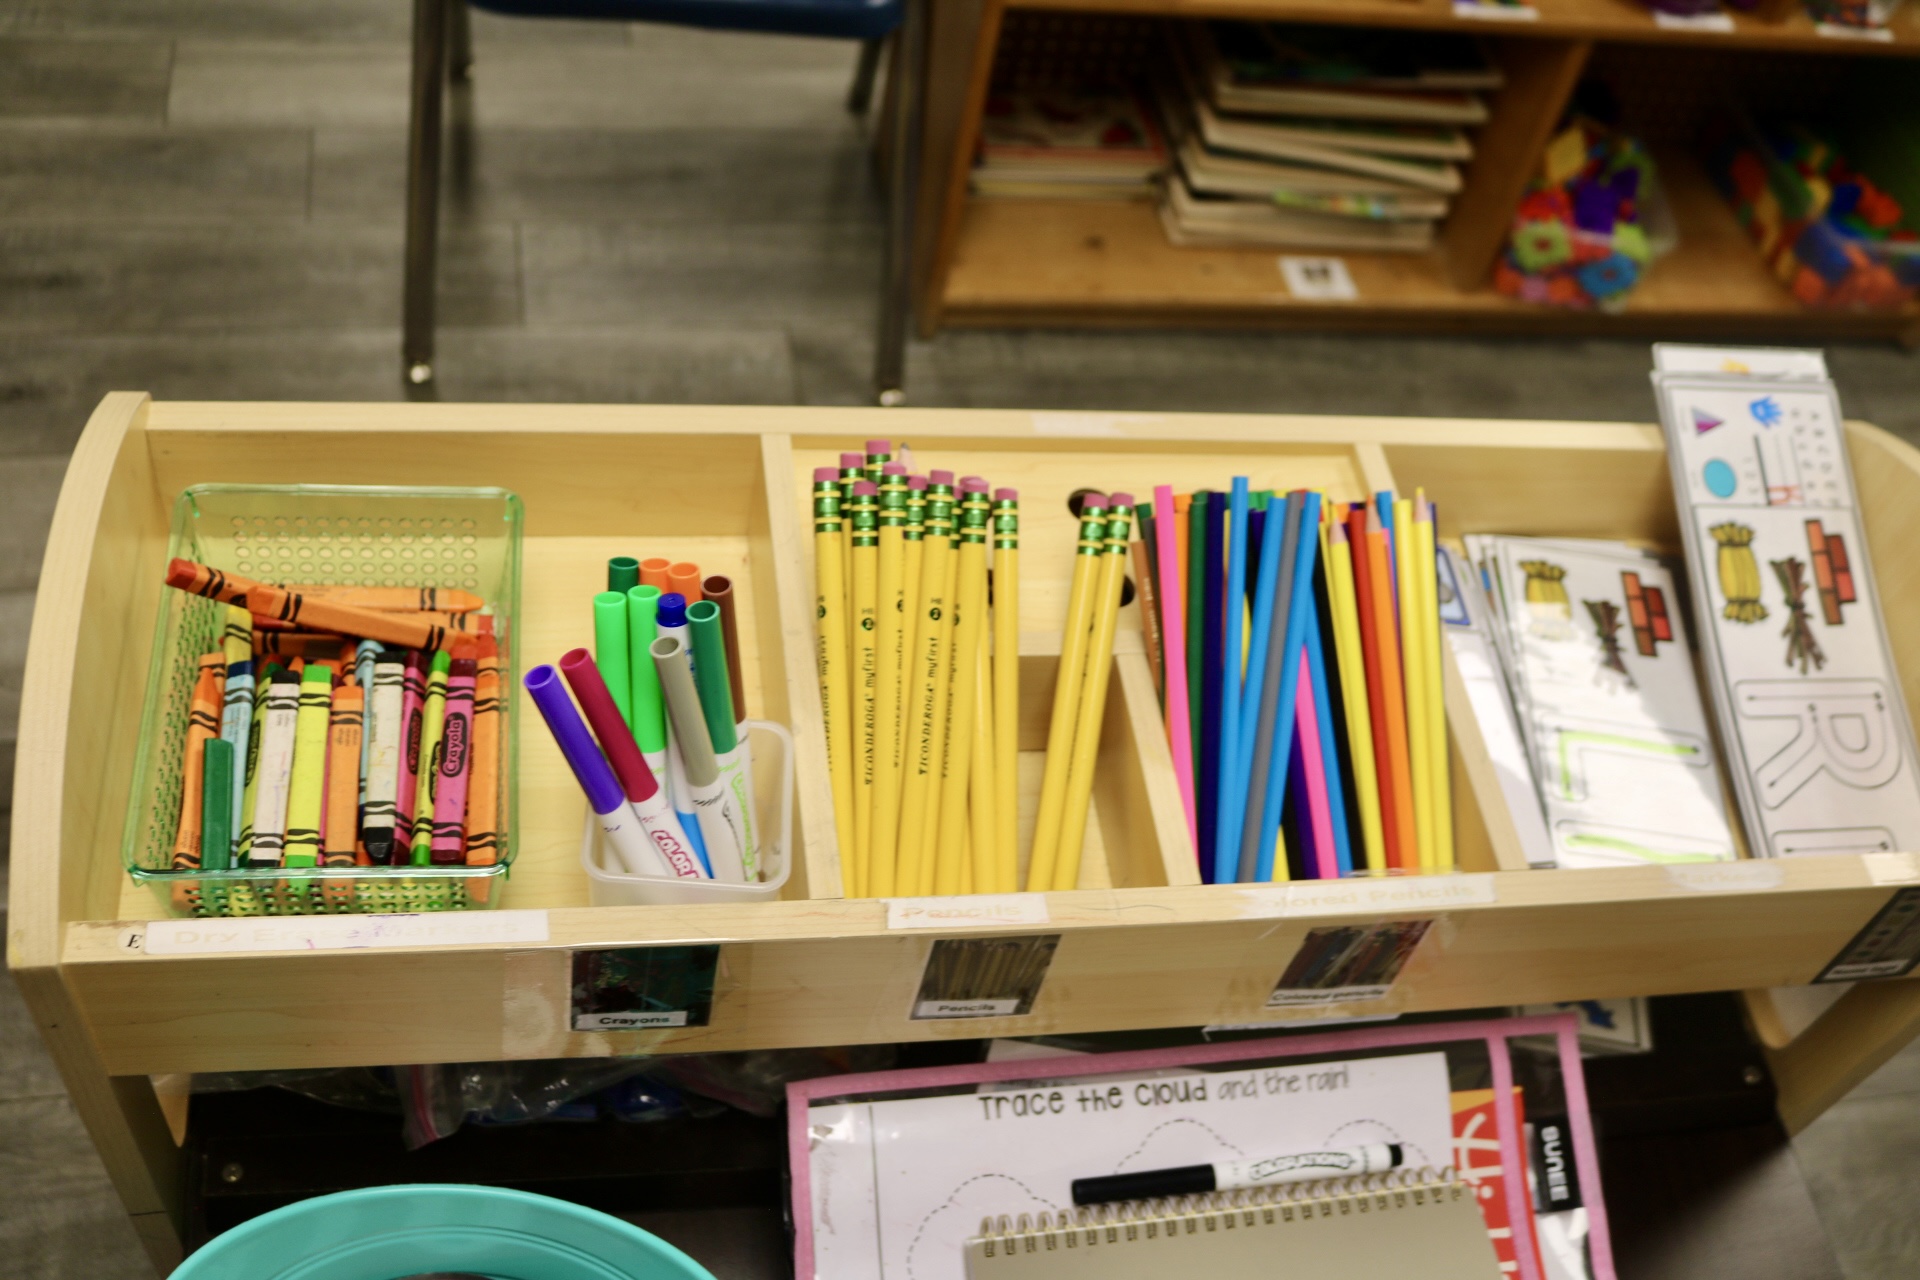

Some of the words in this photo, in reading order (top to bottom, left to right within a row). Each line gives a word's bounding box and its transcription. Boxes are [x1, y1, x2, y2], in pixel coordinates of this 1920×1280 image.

[861, 647, 876, 688] myfirst
[918, 683, 934, 775] TICONDEROGA
[926, 637, 940, 678] myfirst
[444, 715, 464, 776] Crayola
[1369, 884, 1474, 901] Pencils
[902, 903, 1023, 920] Pencils
[125, 934, 143, 949] E
[173, 929, 238, 947] Dry
[938, 1003, 996, 1014] Pencils
[599, 1016, 670, 1026] Crayons
[979, 1089, 1065, 1120] Trace
[1075, 1084, 1123, 1112] the
[1134, 1077, 1208, 1107] Cloud
[1218, 1073, 1258, 1100] and
[1264, 1070, 1300, 1095] the
